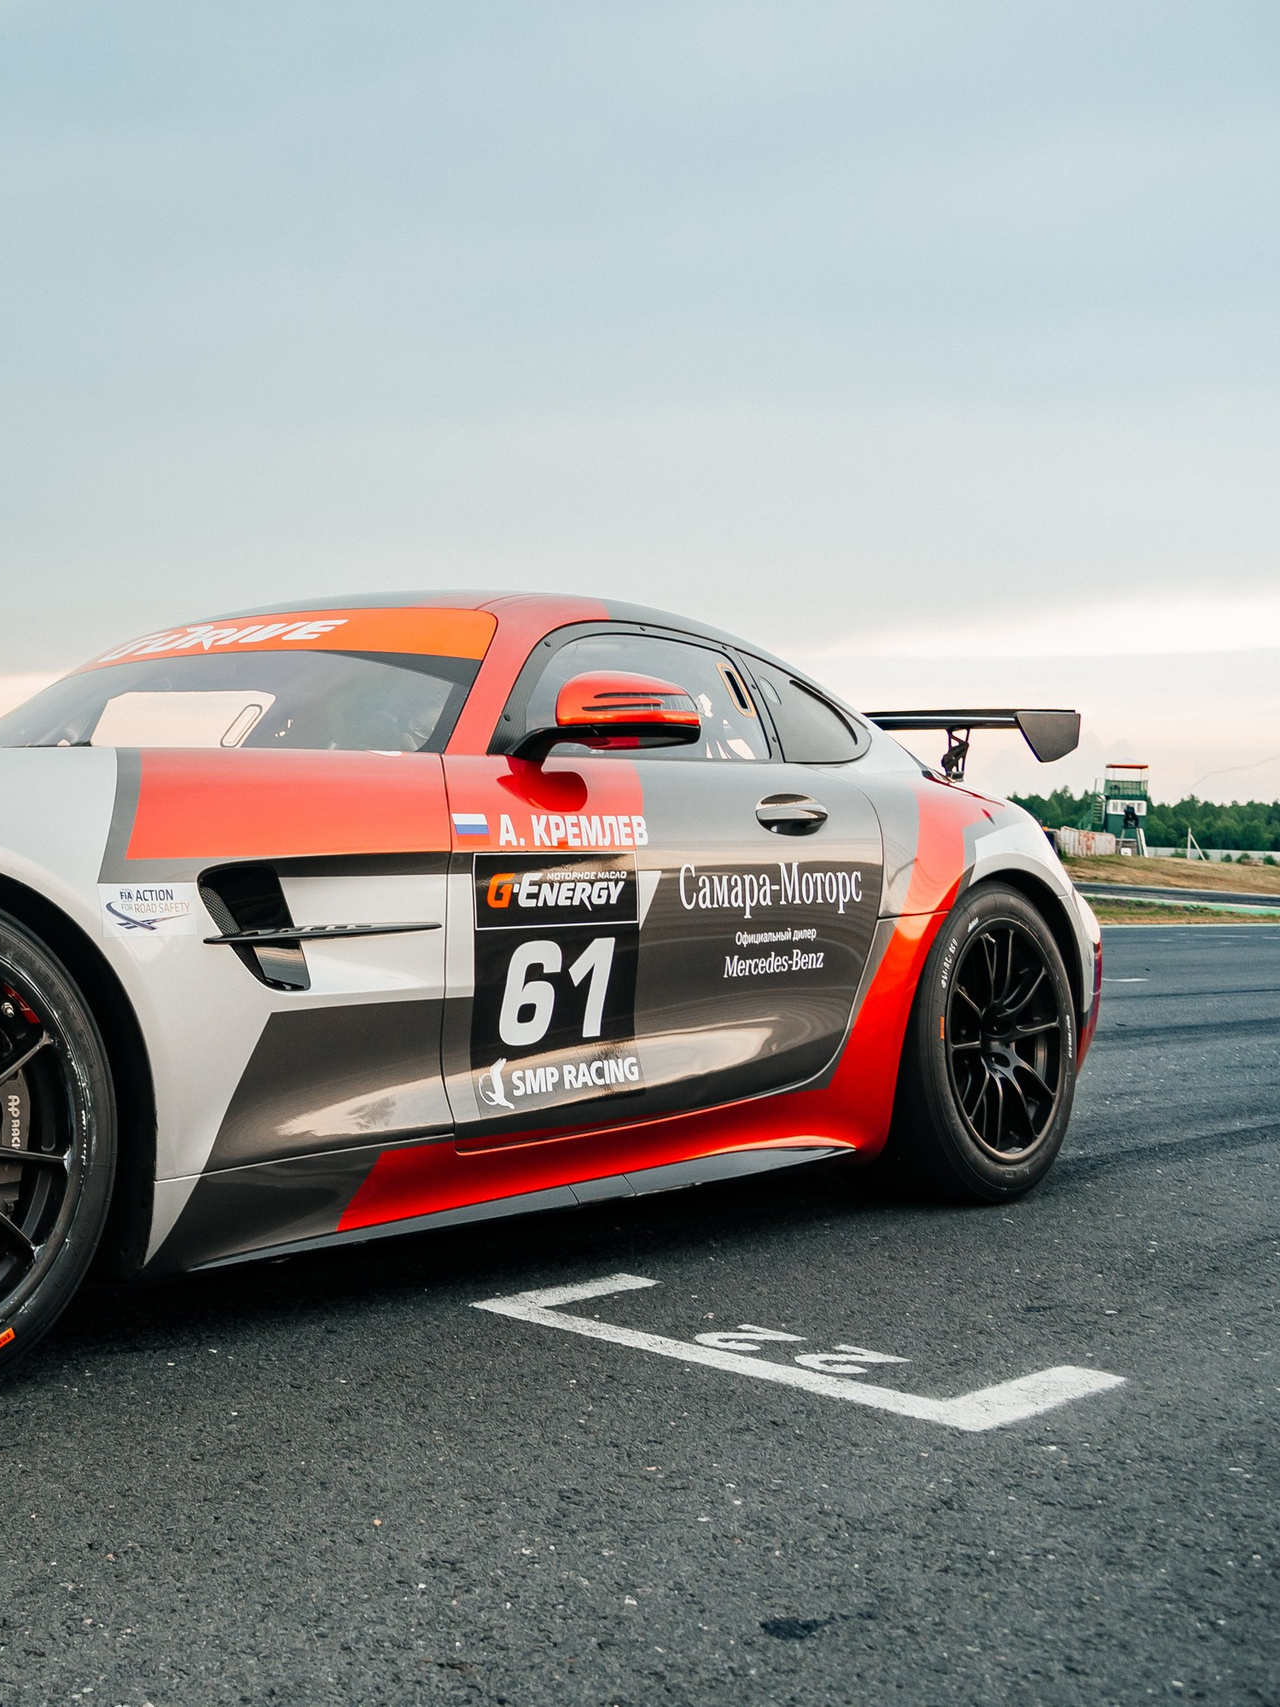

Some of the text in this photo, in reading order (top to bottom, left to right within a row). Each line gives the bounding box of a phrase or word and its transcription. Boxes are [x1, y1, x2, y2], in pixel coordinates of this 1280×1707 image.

[499, 814, 649, 847] А. КРЕМЛЕВ
[546, 870, 628, 881] МОТОРНОЕ МАСЛО
[678, 861, 863, 919] Самара-Моторс
[134, 903, 157, 914] ROAD
[158, 902, 190, 913] SAFETY
[135, 889, 174, 902] ACTION
[735, 927, 817, 948] Официальный дилер
[723, 948, 824, 979] Mercedes-Benz
[498, 937, 616, 1046] 61
[511, 1057, 640, 1097] SMP RACING
